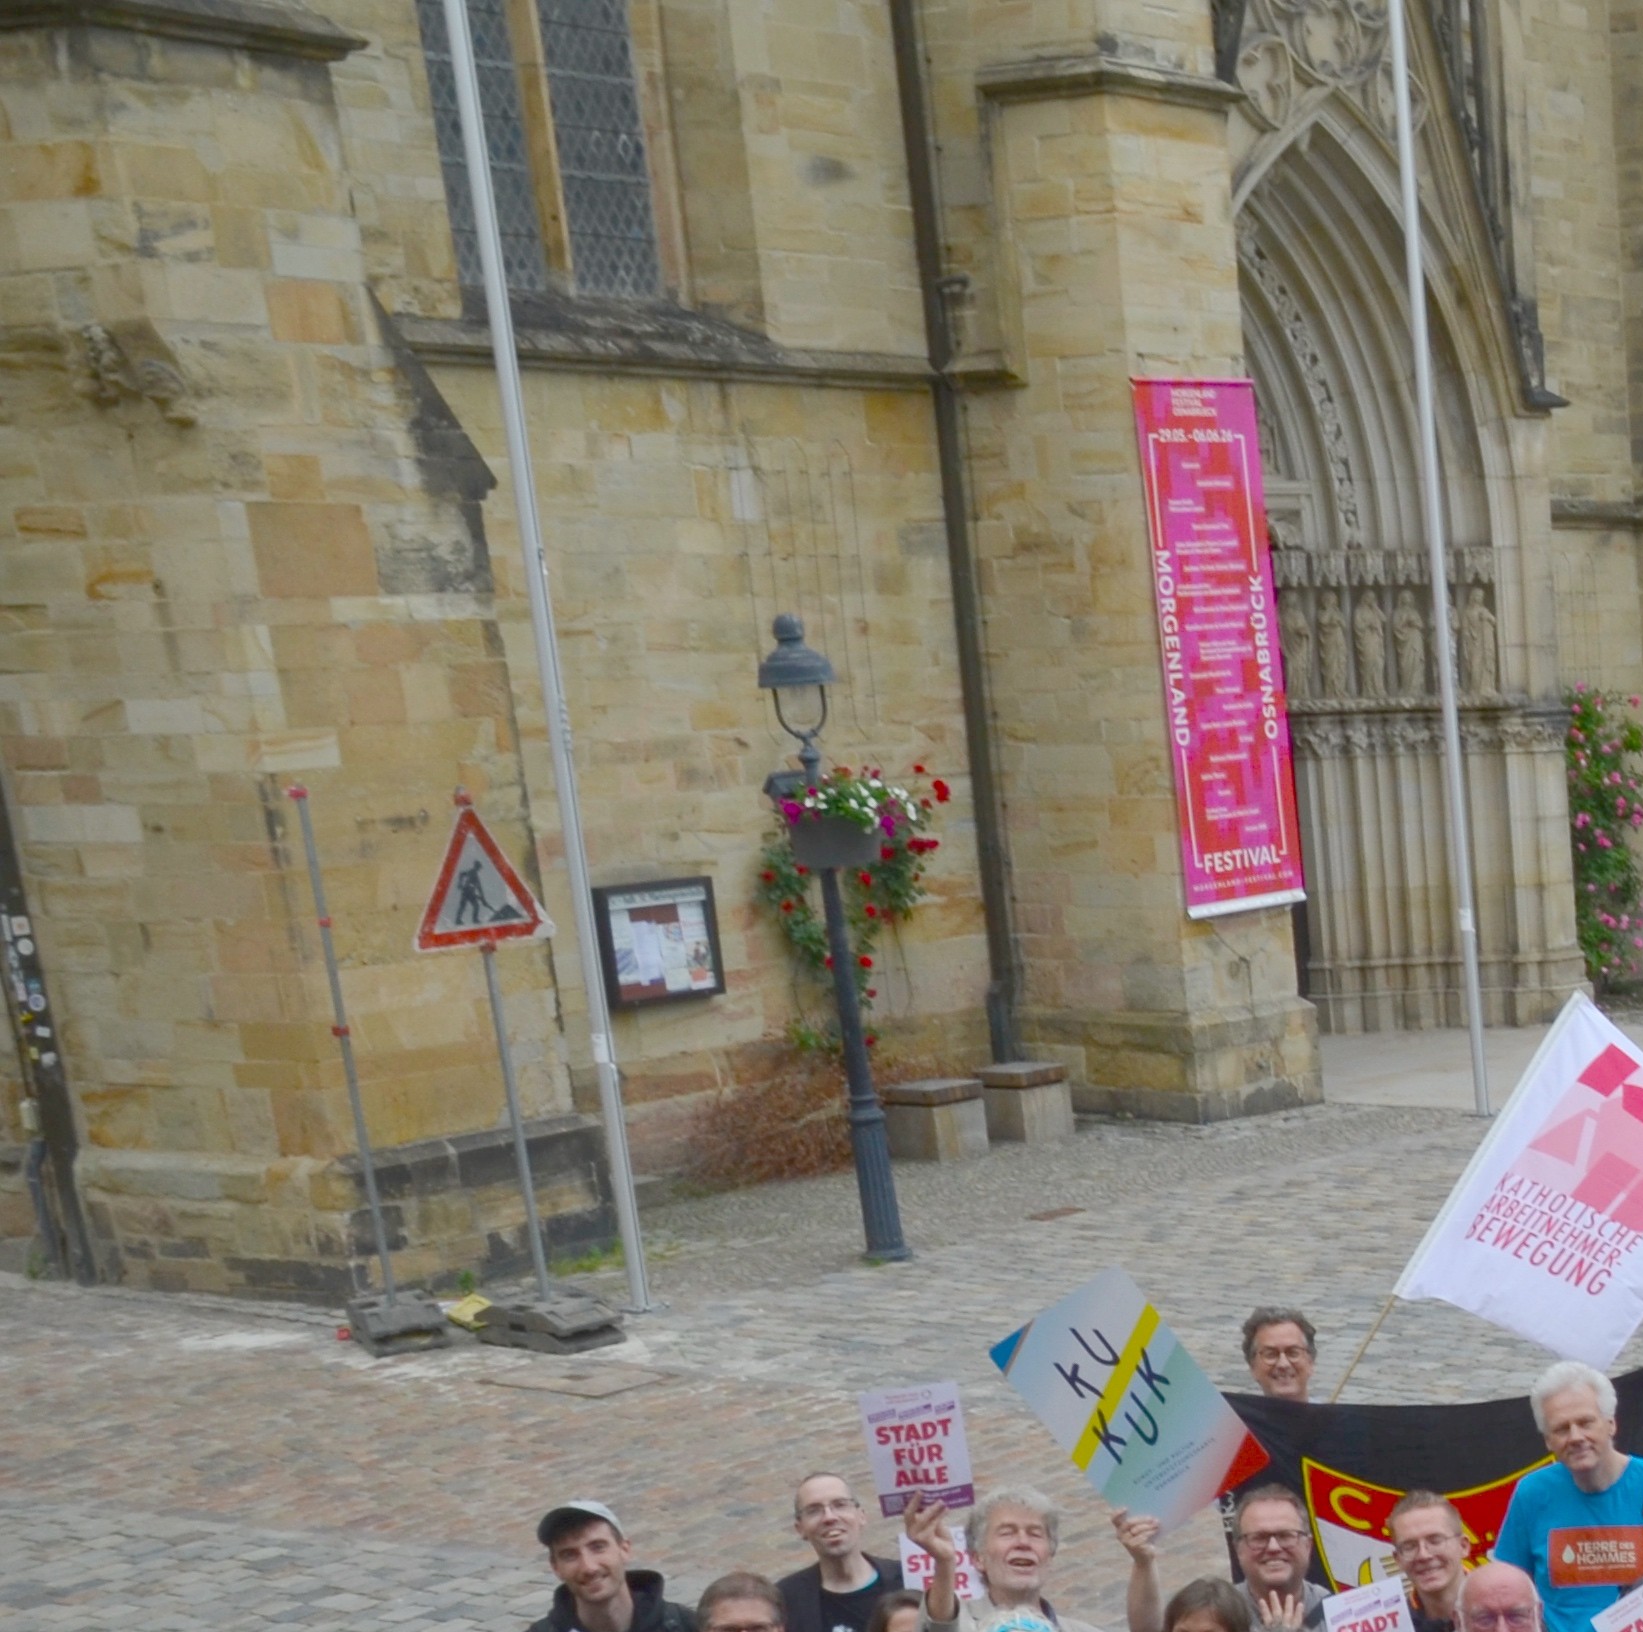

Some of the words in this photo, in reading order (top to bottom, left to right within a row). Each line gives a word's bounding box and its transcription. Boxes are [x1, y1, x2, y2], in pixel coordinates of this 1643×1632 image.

[1156, 550, 1190, 746] MORGENLAND
[1248, 575, 1279, 740] OSNABRÜCK
[1203, 844, 1281, 874] FESTIVAL
[1464, 1213, 1612, 1296] BEWEGUNG
[1481, 1193, 1622, 1268] ARBEITNEHMER-
[1054, 1327, 1120, 1399] KU
[1092, 1347, 1170, 1465] KUK
[876, 1418, 951, 1446] STADT
[893, 1443, 944, 1466] FÜR
[894, 1466, 949, 1488] ALLE
[1576, 1541, 1617, 1552] TERRE
[1576, 1552, 1635, 1566] HOMMES
